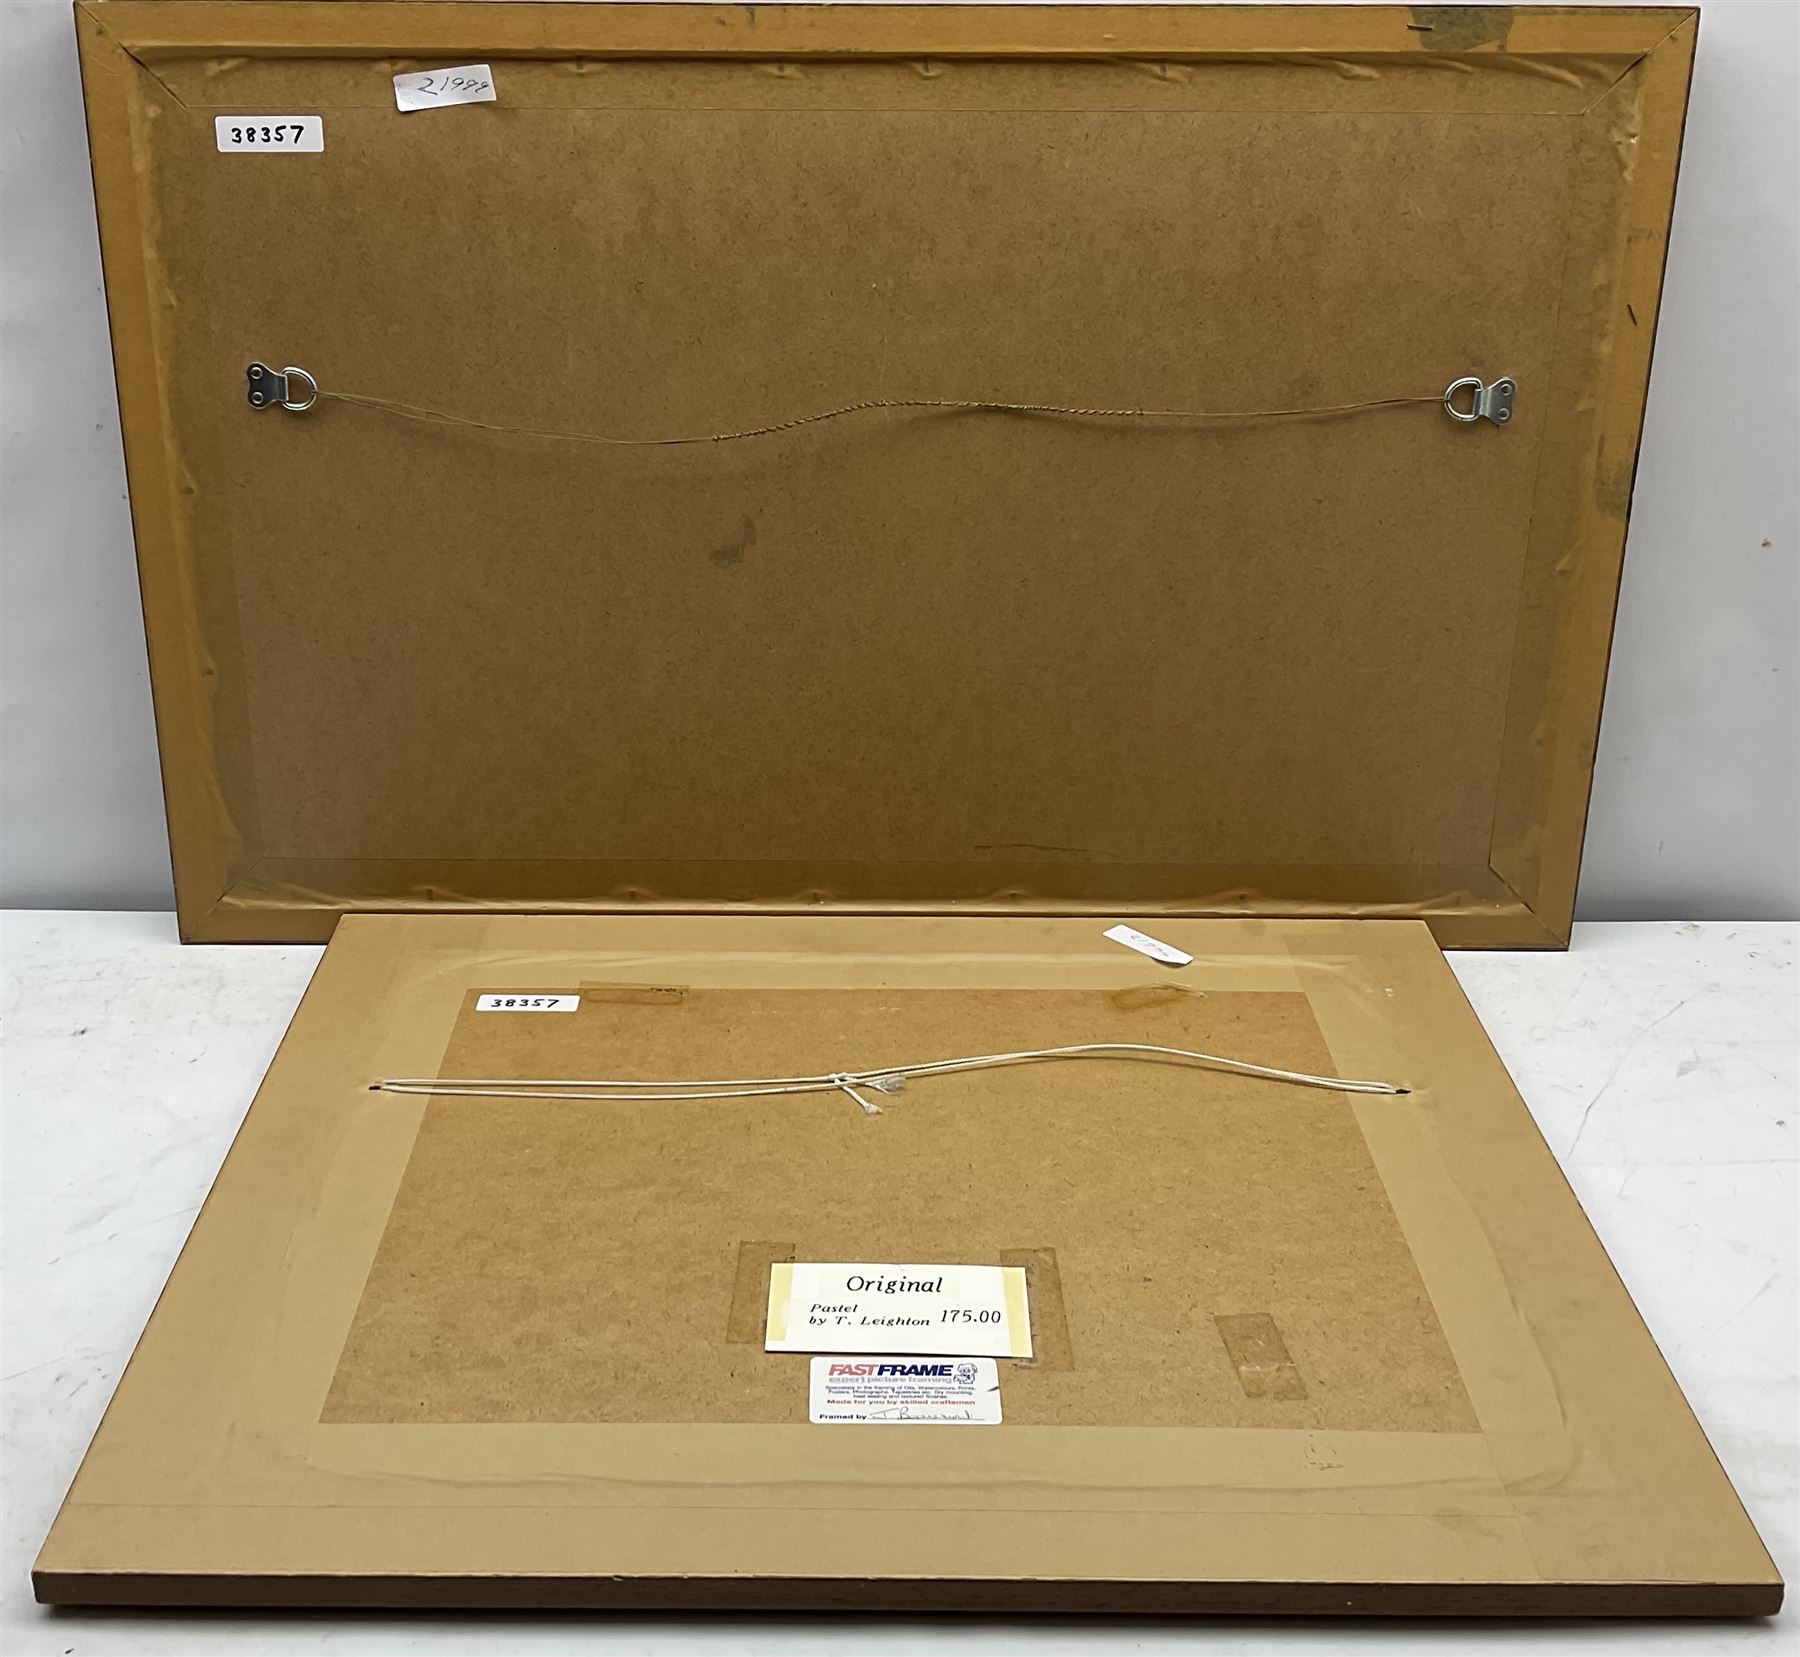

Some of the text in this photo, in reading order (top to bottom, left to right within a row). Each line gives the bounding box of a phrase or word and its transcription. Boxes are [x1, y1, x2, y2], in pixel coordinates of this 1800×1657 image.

[230, 124, 305, 145] 38357
[490, 998, 560, 1008] 38357
[846, 1274, 943, 1295] Original
[810, 1303, 858, 1313] Pastel
[808, 1316, 931, 1327] by T. Leighton
[940, 1309, 1001, 1324] 175.00
[828, 1376, 952, 1385] expert picture framing
